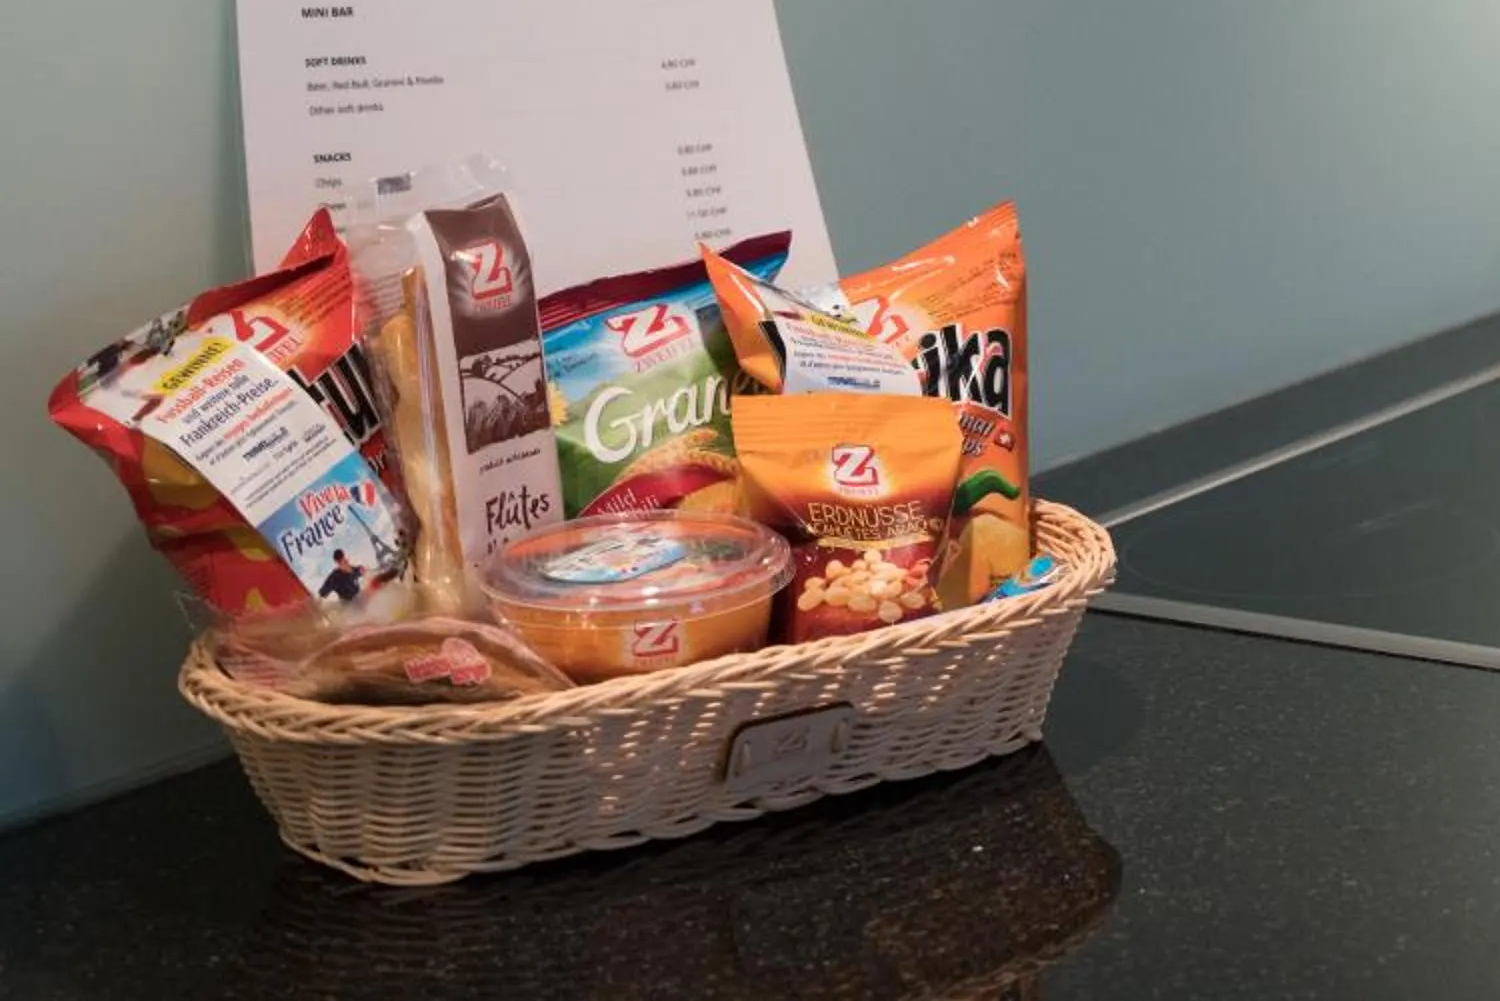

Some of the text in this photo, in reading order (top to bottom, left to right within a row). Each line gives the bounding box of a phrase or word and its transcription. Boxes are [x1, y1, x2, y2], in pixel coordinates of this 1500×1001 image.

[301, 6, 354, 18] MINI BAR
[305, 56, 367, 67] SOFT DRINKS
[313, 152, 352, 163] SNACKS
[916, 324, 1011, 416] ika
[179, 377, 280, 448] Frankreich-Preise.
[583, 374, 734, 464] Gran
[832, 443, 880, 487] Z
[281, 503, 345, 563] France
[485, 484, 550, 535] Flûtes
[807, 499, 925, 528] ERDNÜSSE
